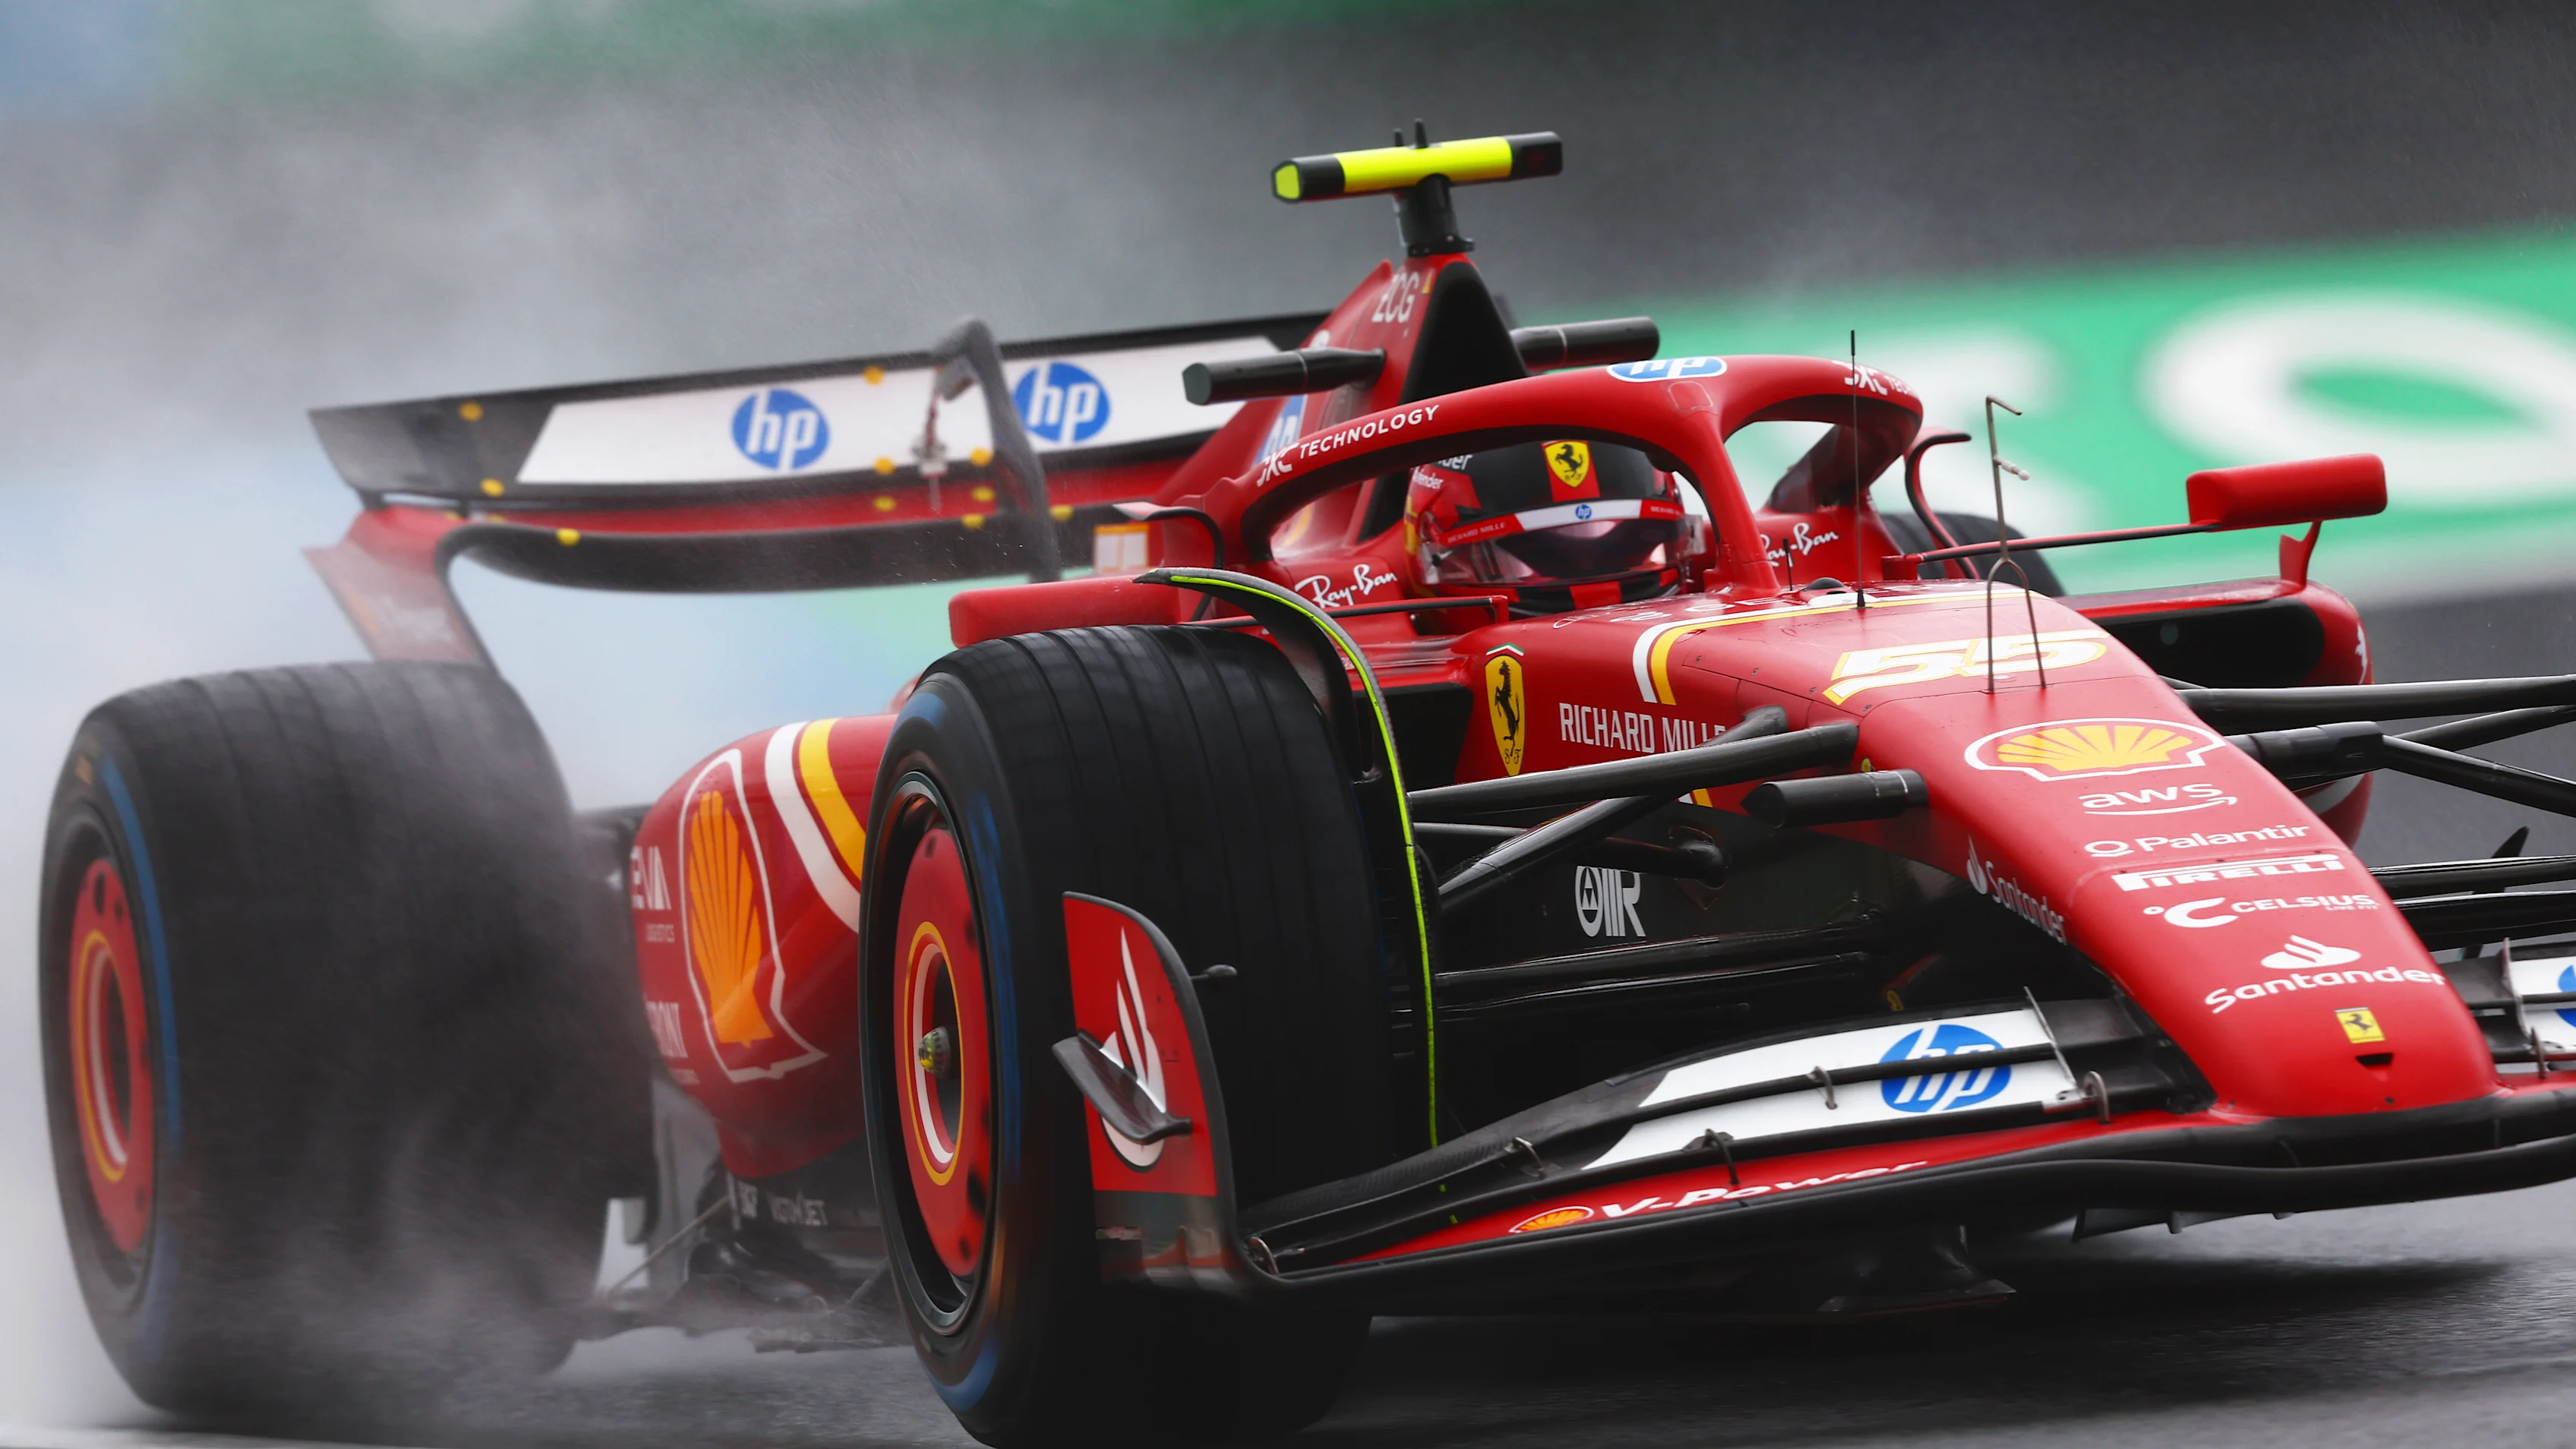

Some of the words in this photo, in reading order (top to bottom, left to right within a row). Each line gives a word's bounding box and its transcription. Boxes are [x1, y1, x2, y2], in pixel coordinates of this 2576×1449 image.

[1027, 362, 1100, 444] hp
[744, 390, 819, 471] hp
[1300, 405, 1440, 459] TECHNOLOGY
[1577, 505, 1591, 519] hp
[1294, 564, 1399, 608] Ray-Ban
[1823, 630, 2109, 706] 55
[1559, 703, 1655, 753] RICHARD
[2078, 782, 2224, 809] aws
[2135, 824, 2310, 853] Palantir
[2111, 854, 2345, 892] PIRELLI
[1986, 860, 2068, 946] Santander
[2205, 967, 2446, 1013] Santander
[1894, 1025, 1996, 1113] hp
[1602, 1160, 1928, 1219] V-Power
